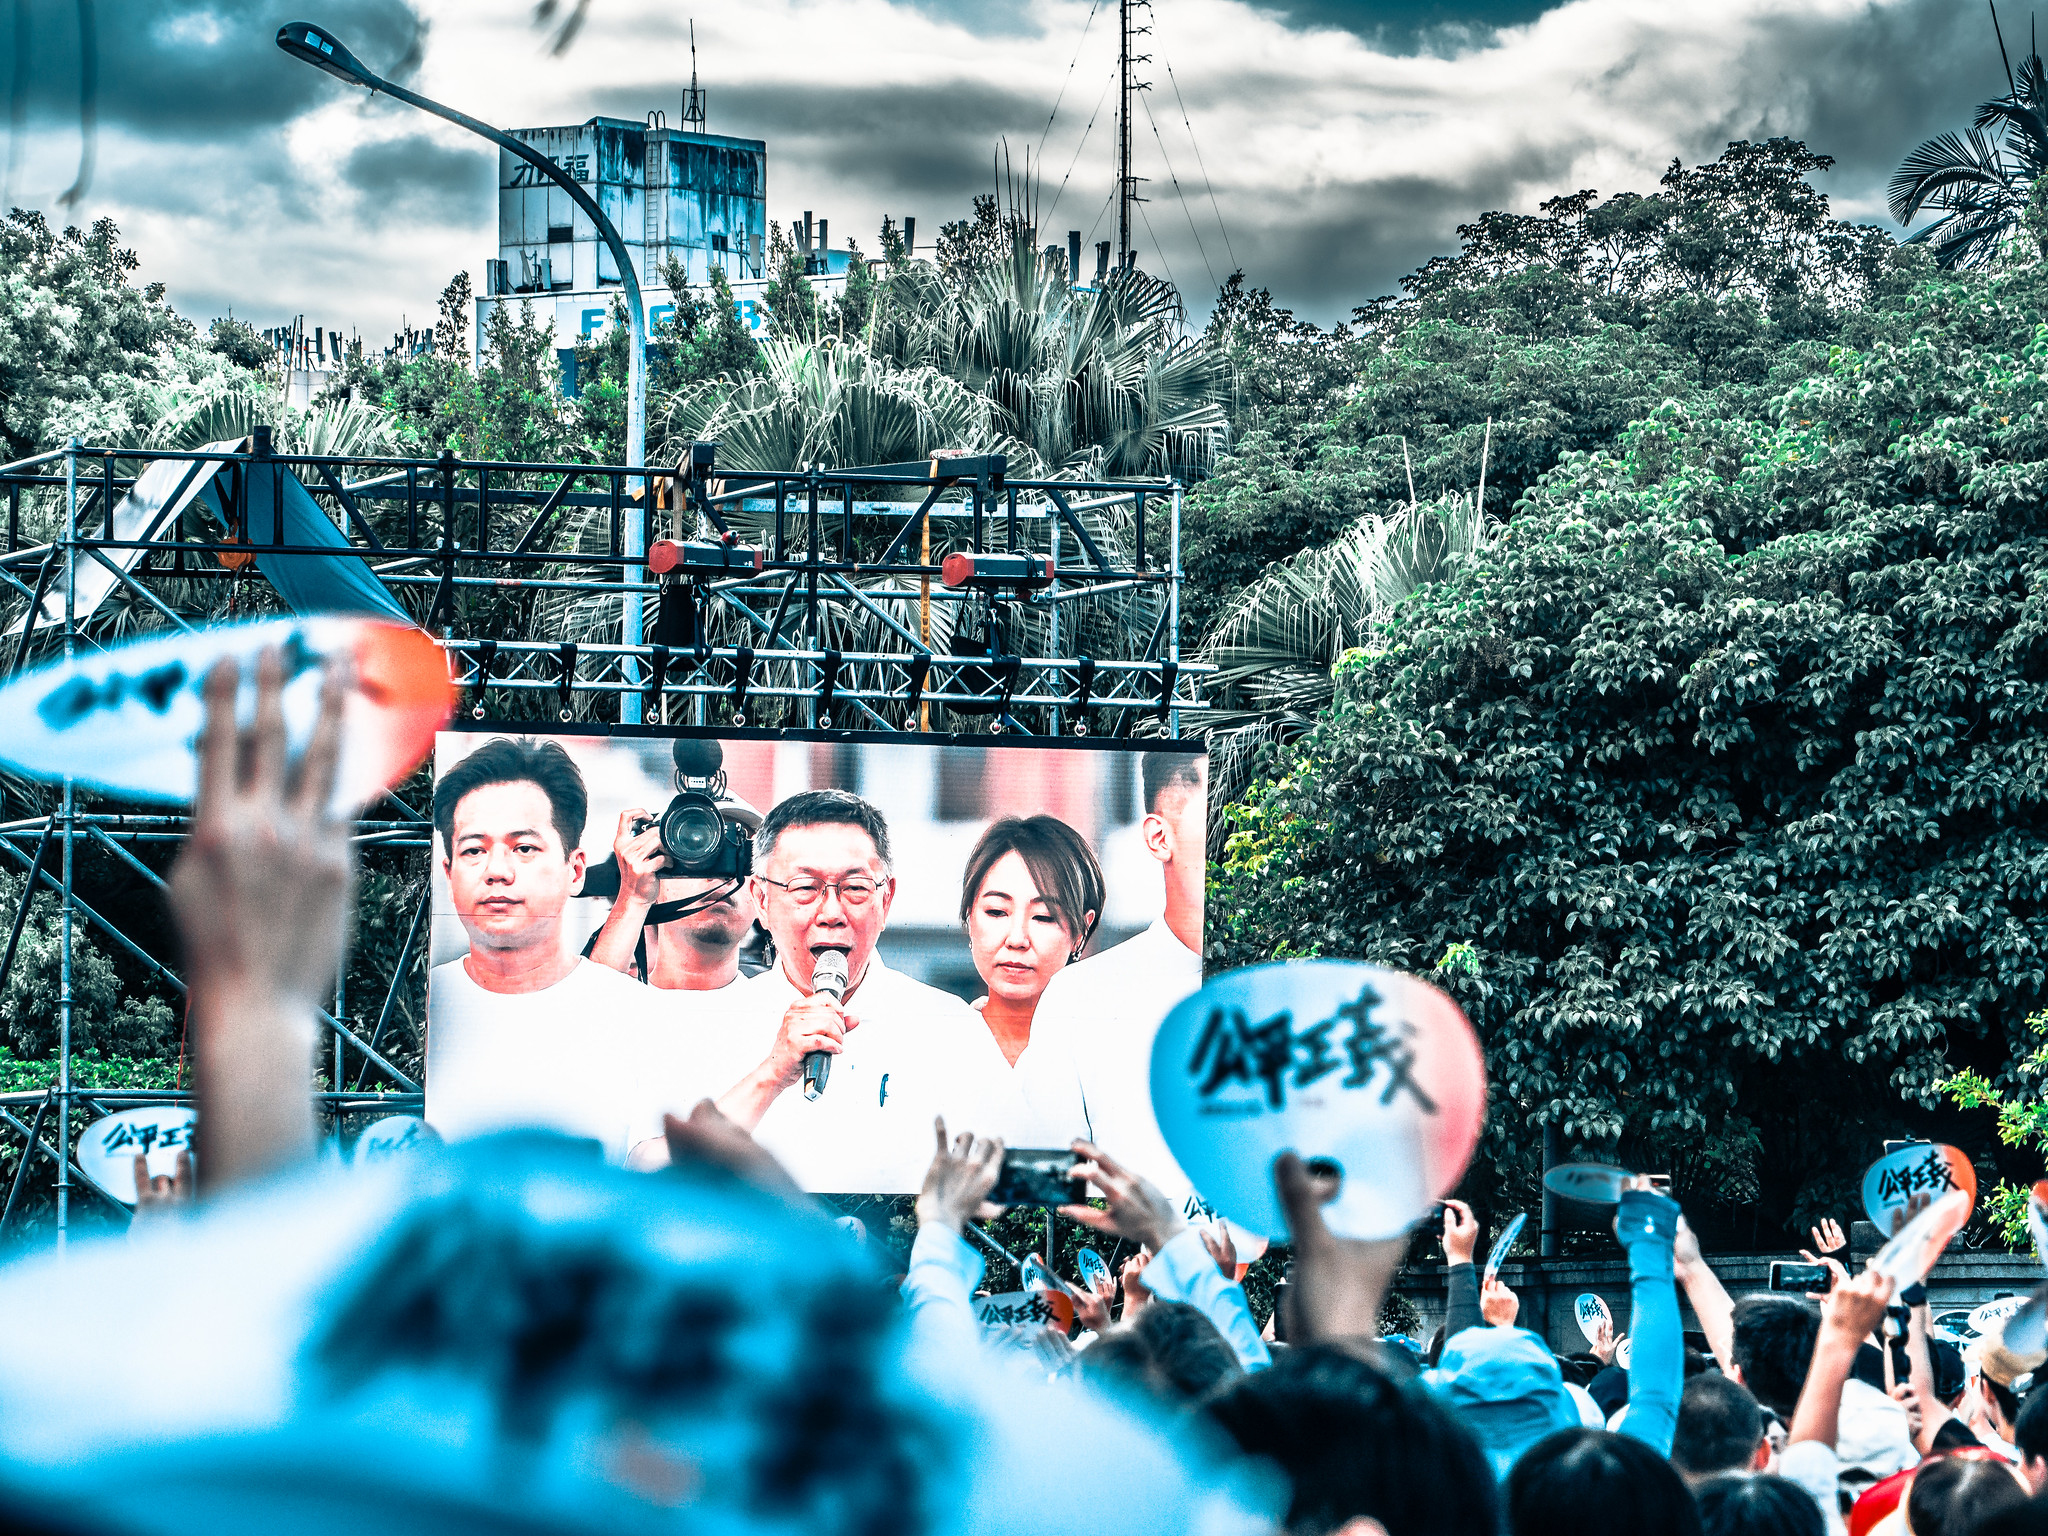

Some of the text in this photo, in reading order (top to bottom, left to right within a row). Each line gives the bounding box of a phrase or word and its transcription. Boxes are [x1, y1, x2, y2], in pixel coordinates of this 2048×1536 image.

[1878, 1149, 1961, 1201] 公平正義
[980, 1292, 1061, 1327] 公平正義
